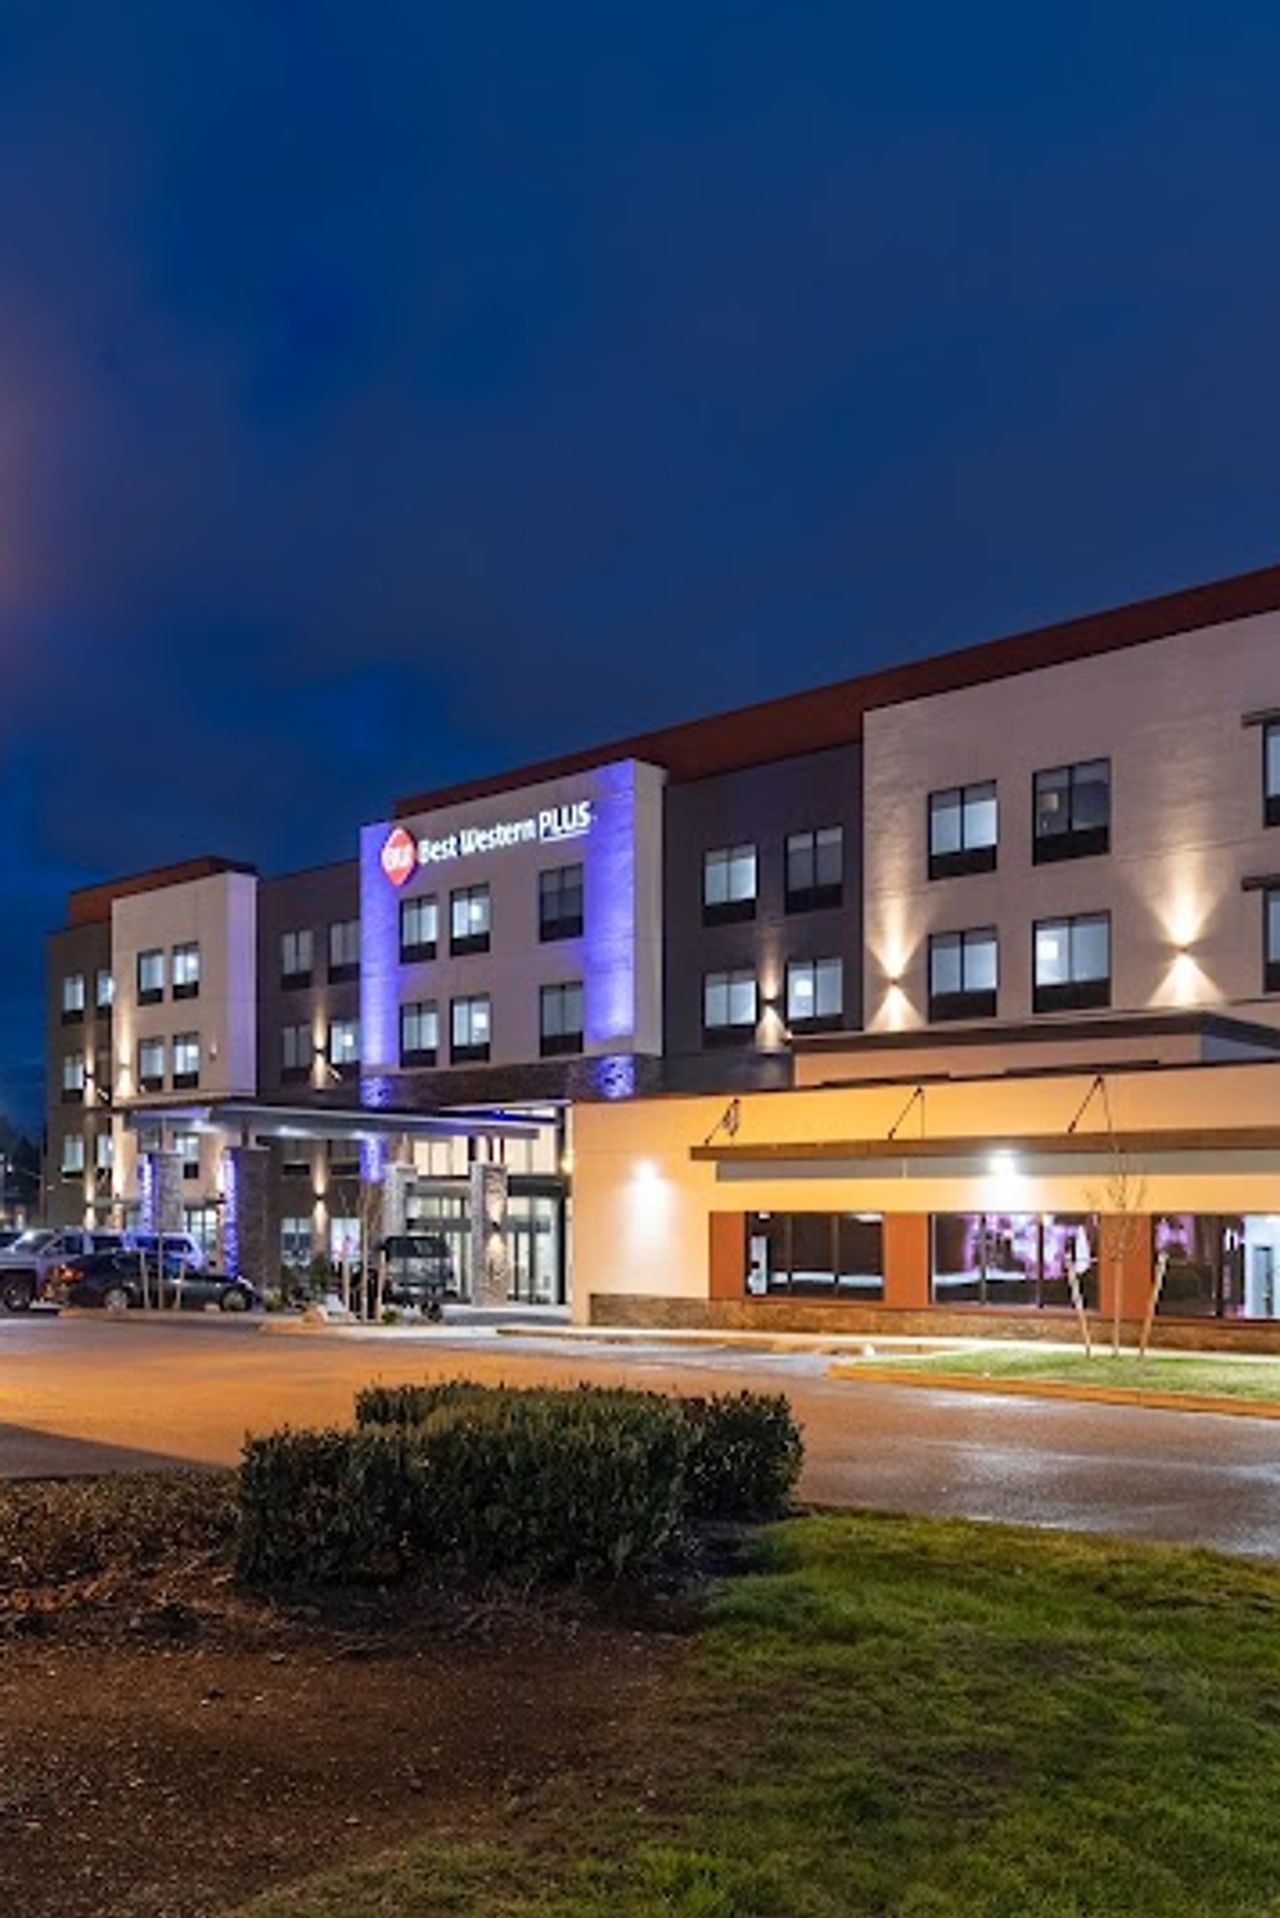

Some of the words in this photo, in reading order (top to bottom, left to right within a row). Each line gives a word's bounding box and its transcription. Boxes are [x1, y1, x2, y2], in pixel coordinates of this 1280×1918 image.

[419, 836, 459, 863] Best
[460, 820, 536, 854] Western
[539, 802, 591, 838] PLUS
